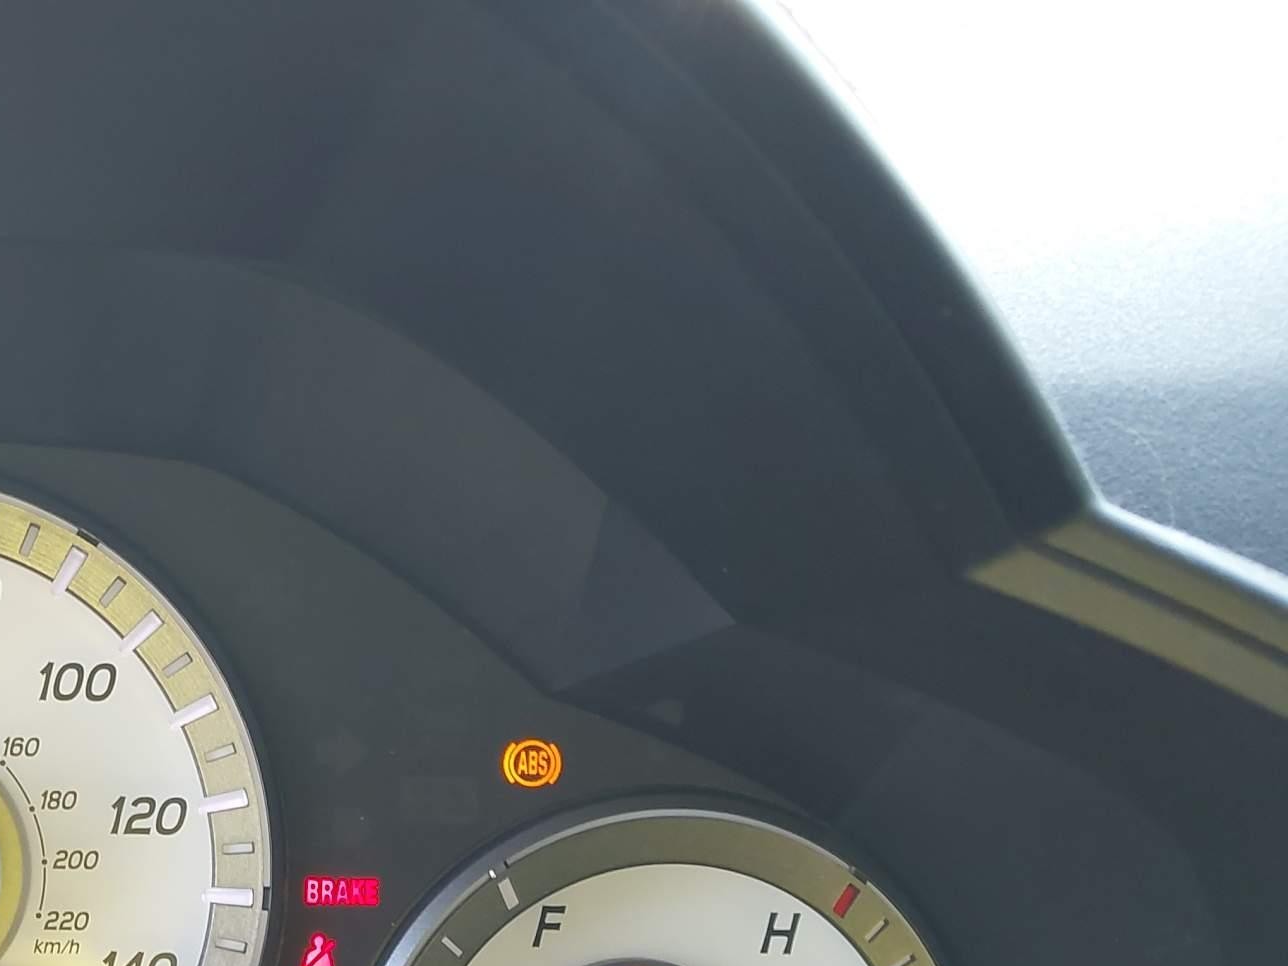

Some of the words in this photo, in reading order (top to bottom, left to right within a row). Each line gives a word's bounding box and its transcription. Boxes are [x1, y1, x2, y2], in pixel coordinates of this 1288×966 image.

[38, 662, 116, 701] 100
[2, 737, 40, 758] 160
[517, 751, 549, 777] ABS
[40, 791, 77, 810] 180
[110, 797, 186, 835] 120
[53, 850, 99, 871] 200
[307, 879, 379, 904] BRAKE
[44, 911, 90, 931] 220
[532, 905, 566, 948] F
[760, 912, 801, 954] H
[33, 939, 80, 956] km/h
